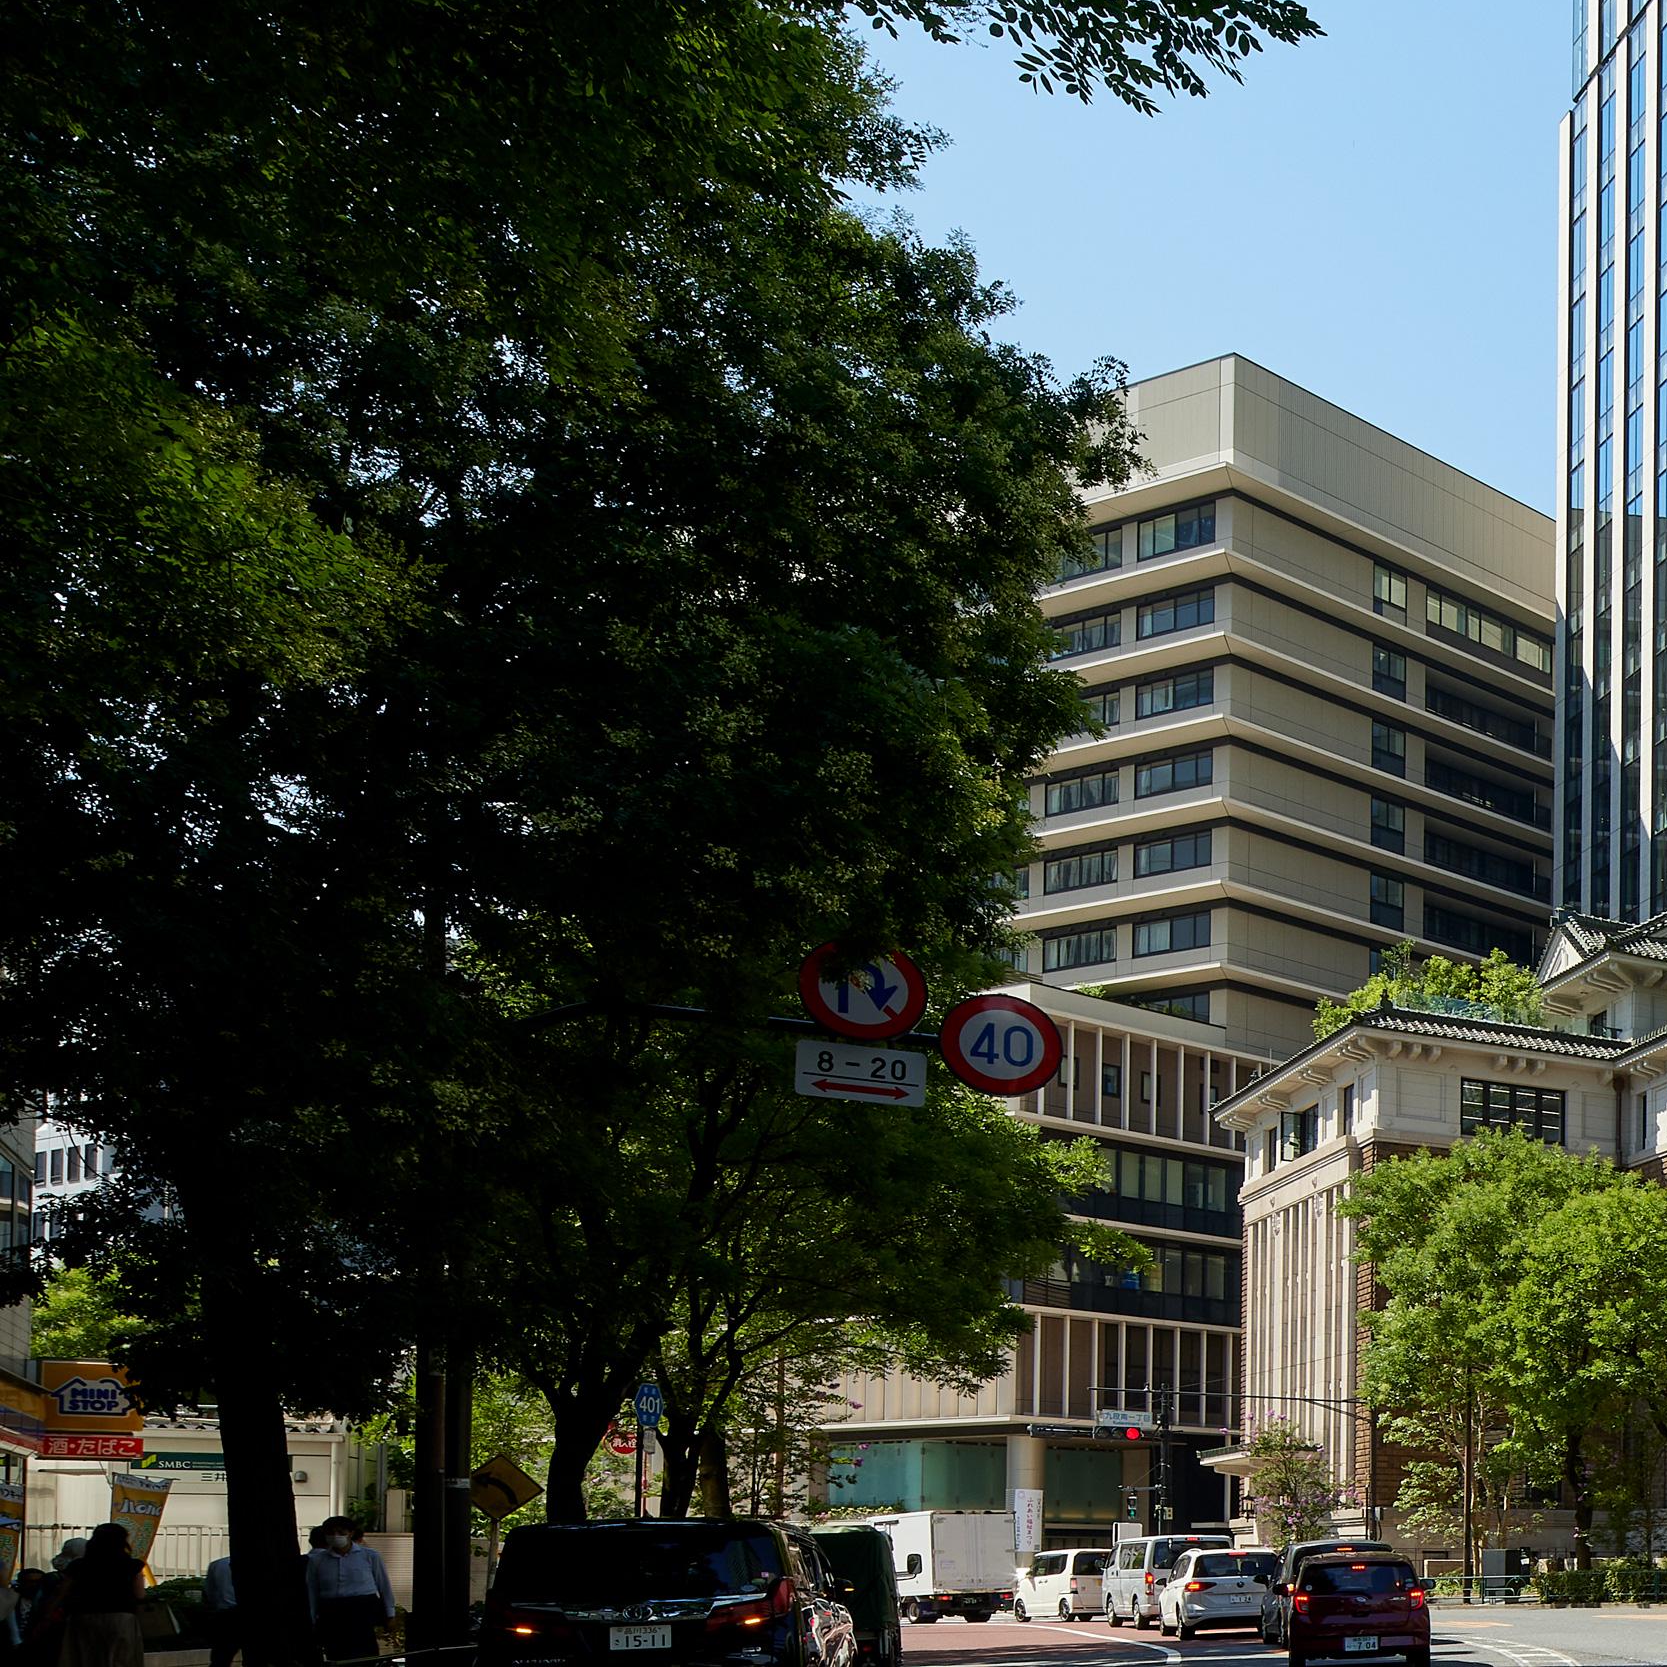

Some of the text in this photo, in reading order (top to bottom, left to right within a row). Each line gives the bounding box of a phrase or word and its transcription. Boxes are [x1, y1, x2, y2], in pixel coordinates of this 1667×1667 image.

[969, 1022, 1034, 1068] 40
[70, 1387, 118, 1400] MINI
[68, 1399, 120, 1412] STOP
[640, 1396, 661, 1414] 401
[48, 1437, 136, 1456] 酒・たばこ
[158, 1460, 191, 1469] SMBC
[625, 1634, 666, 1648] 15-11
